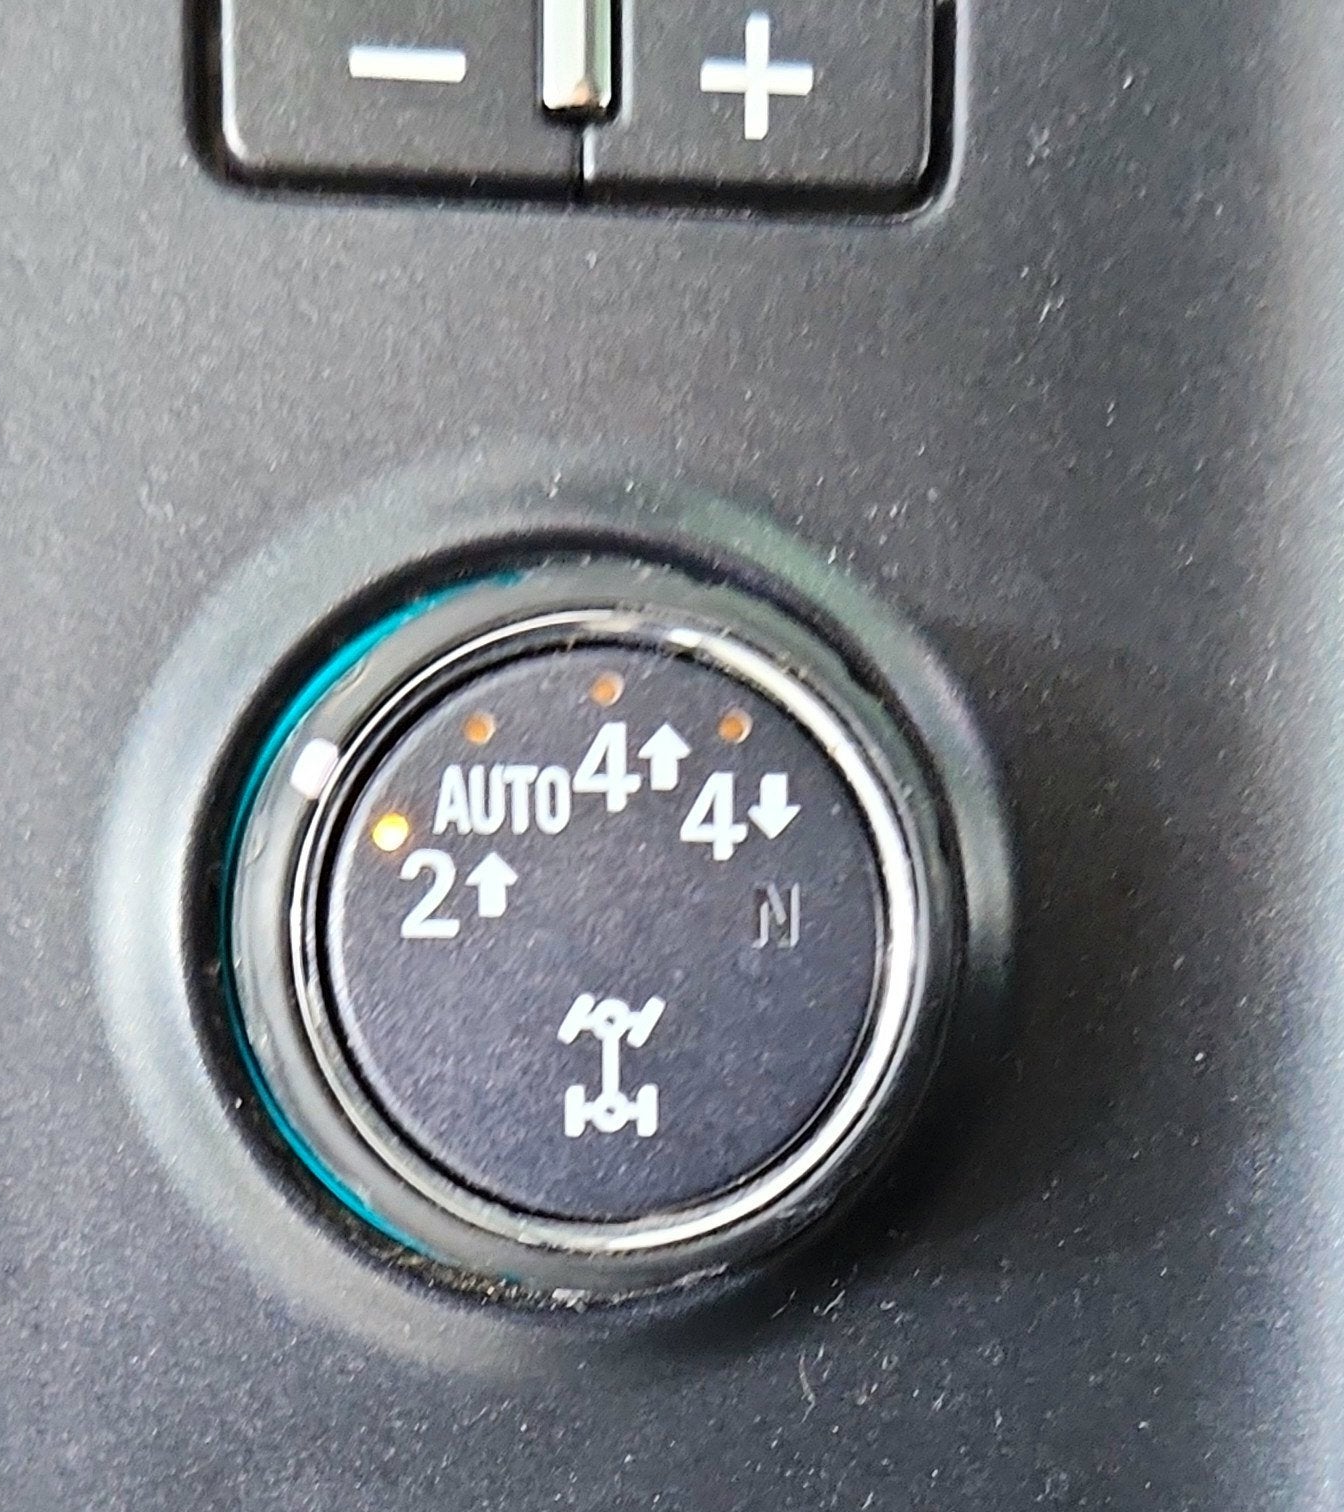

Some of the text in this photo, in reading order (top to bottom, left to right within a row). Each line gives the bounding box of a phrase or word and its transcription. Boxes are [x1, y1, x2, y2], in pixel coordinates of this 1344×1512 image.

[433, 763, 572, 836] AUTO
[572, 721, 641, 813] 4
[679, 771, 749, 861] 4
[399, 847, 461, 939] 2
